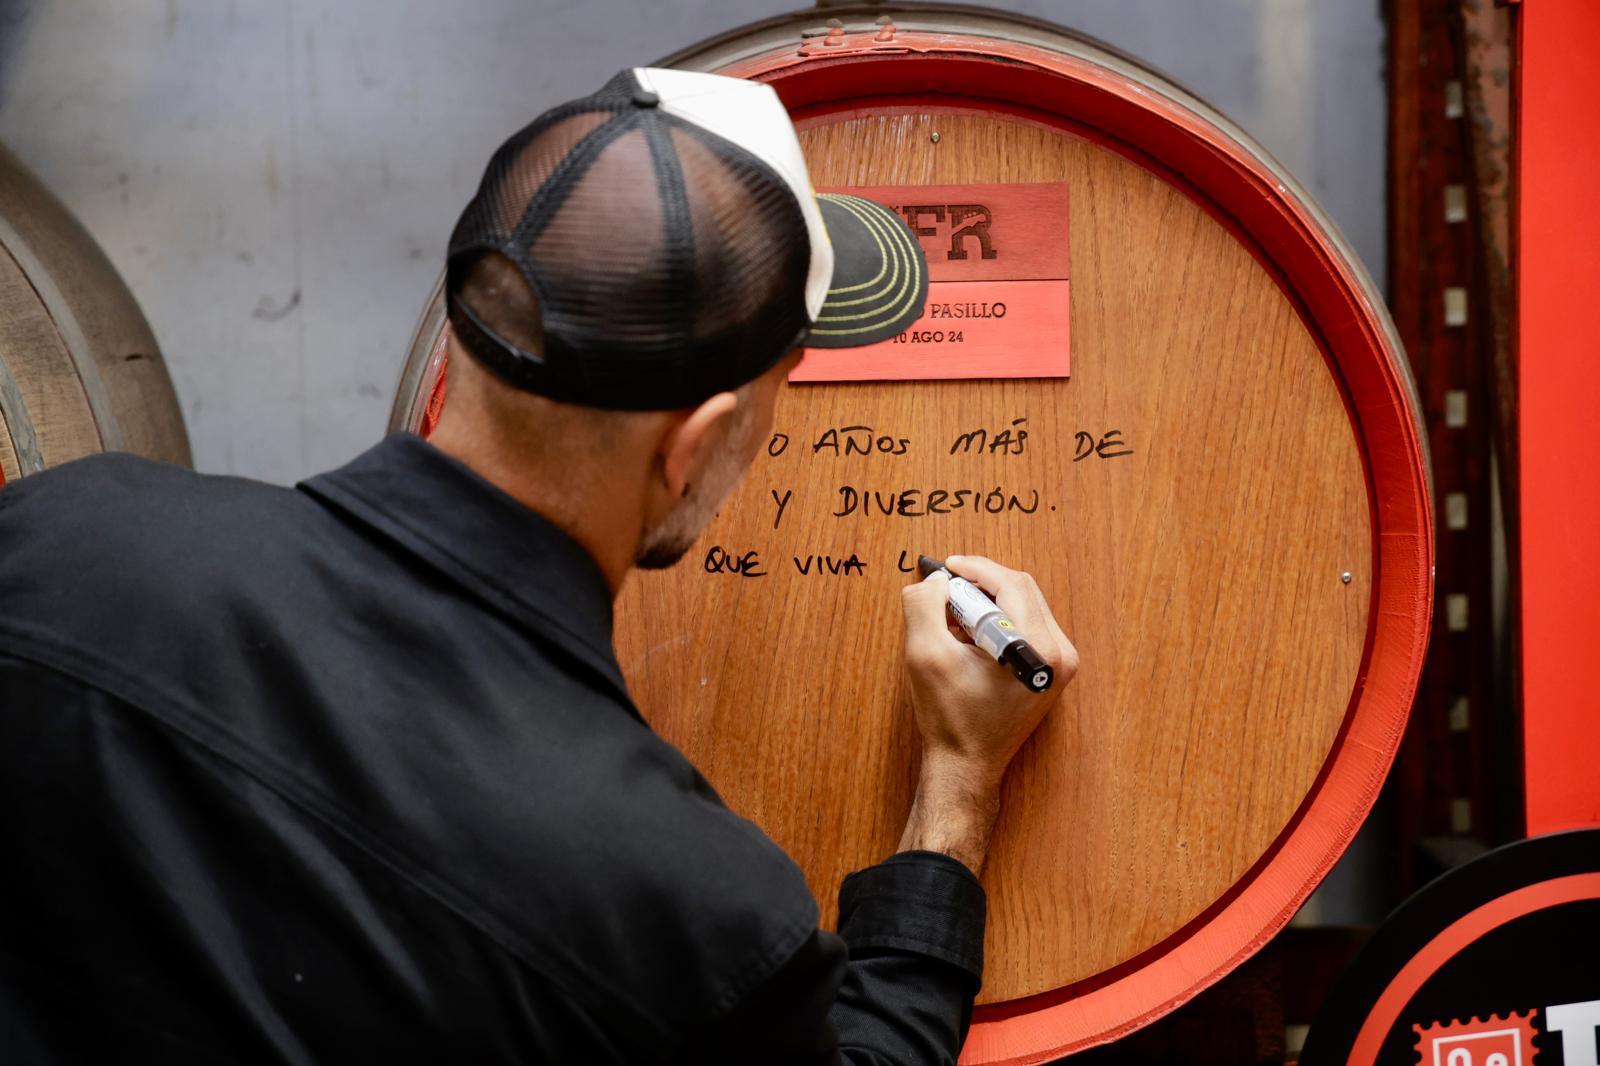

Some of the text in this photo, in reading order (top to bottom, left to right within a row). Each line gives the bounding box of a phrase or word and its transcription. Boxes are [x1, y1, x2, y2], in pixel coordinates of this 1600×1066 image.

[929, 302, 1007, 319] PASILLO
[910, 331, 944, 344] AGO
[948, 331, 964, 343] 24
[812, 425, 911, 457] AÑOS
[949, 418, 1030, 456] MÁS
[1072, 430, 1135, 463] DE
[771, 485, 1057, 530] Y DIVERSIÓN.
[704, 545, 769, 578] QUE
[793, 553, 869, 577] VIVA
